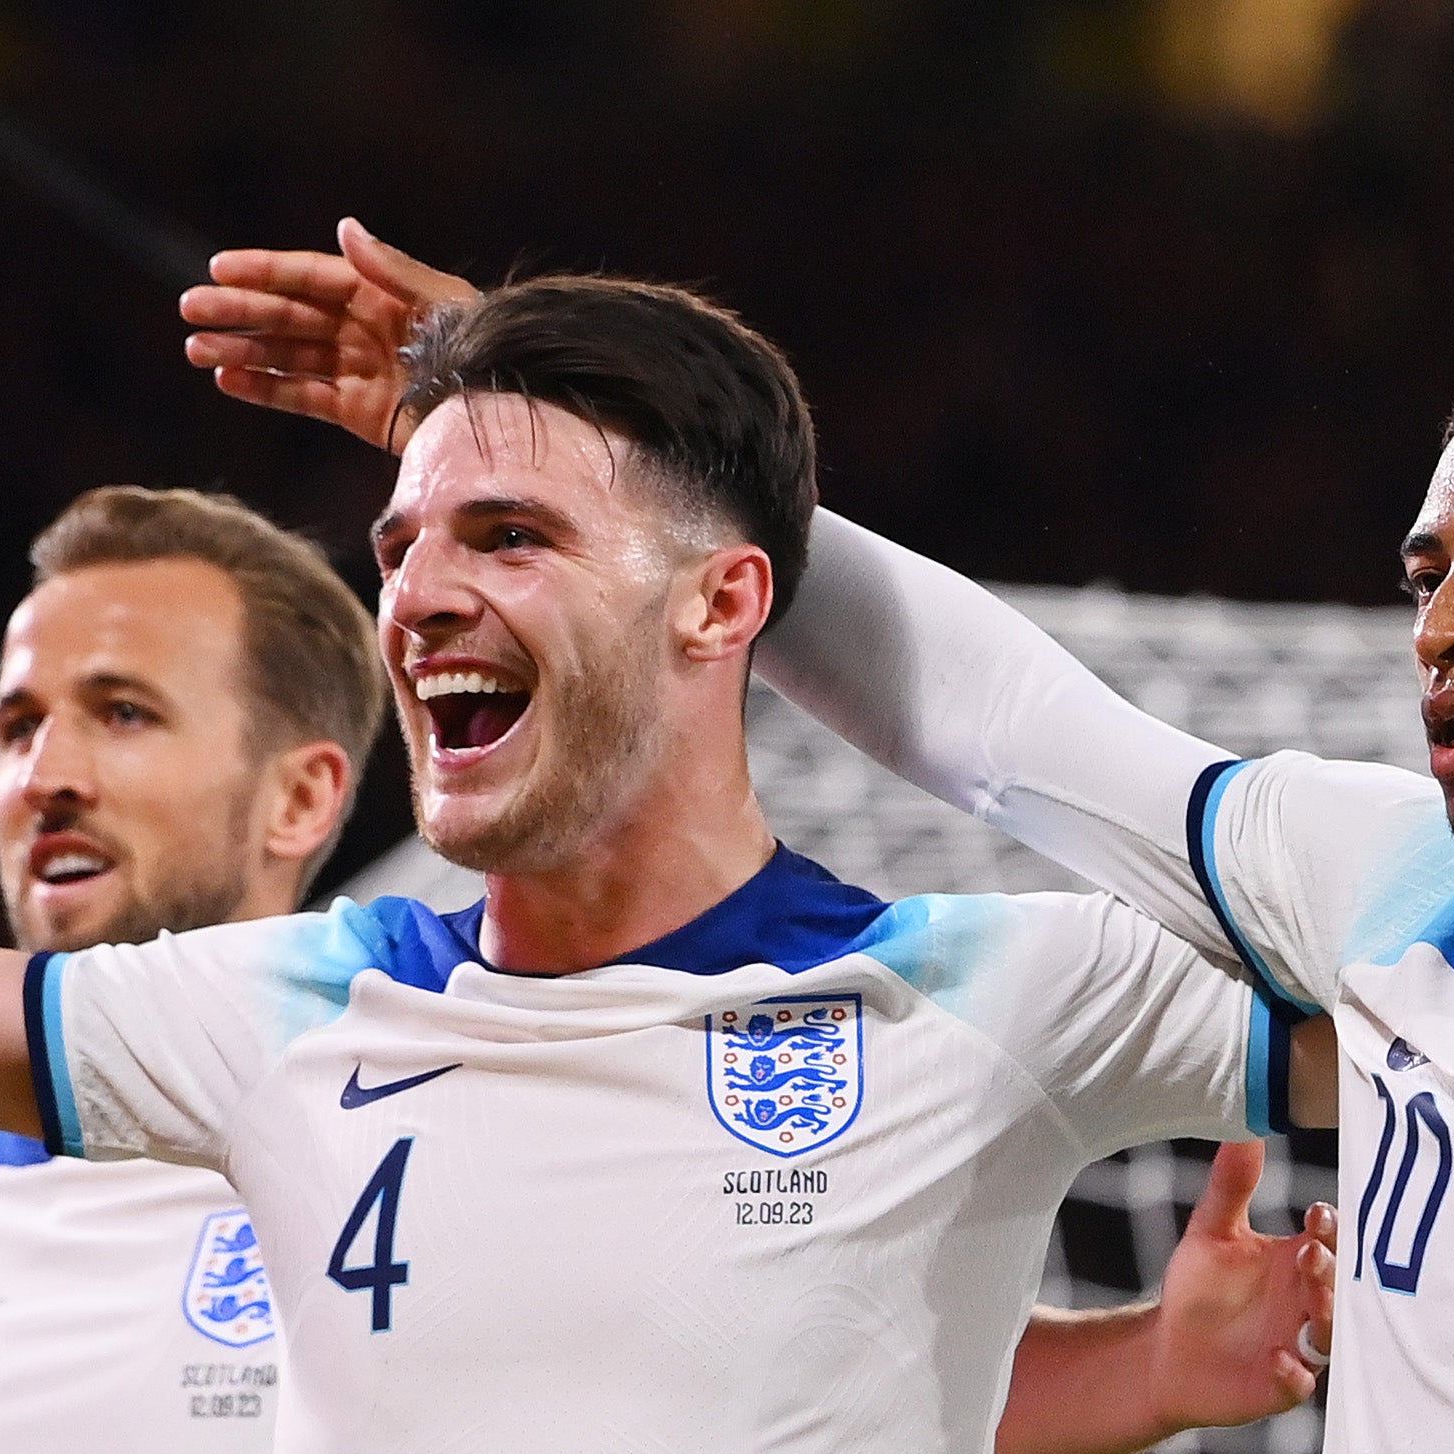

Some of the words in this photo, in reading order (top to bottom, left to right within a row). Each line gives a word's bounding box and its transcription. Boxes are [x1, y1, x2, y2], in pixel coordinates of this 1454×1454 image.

[326, 1135, 416, 1334] 4
[722, 1168, 828, 1195] SCOTLAND
[735, 1201, 814, 1225] 12.09.23
[1353, 1072, 1453, 1296] 10
